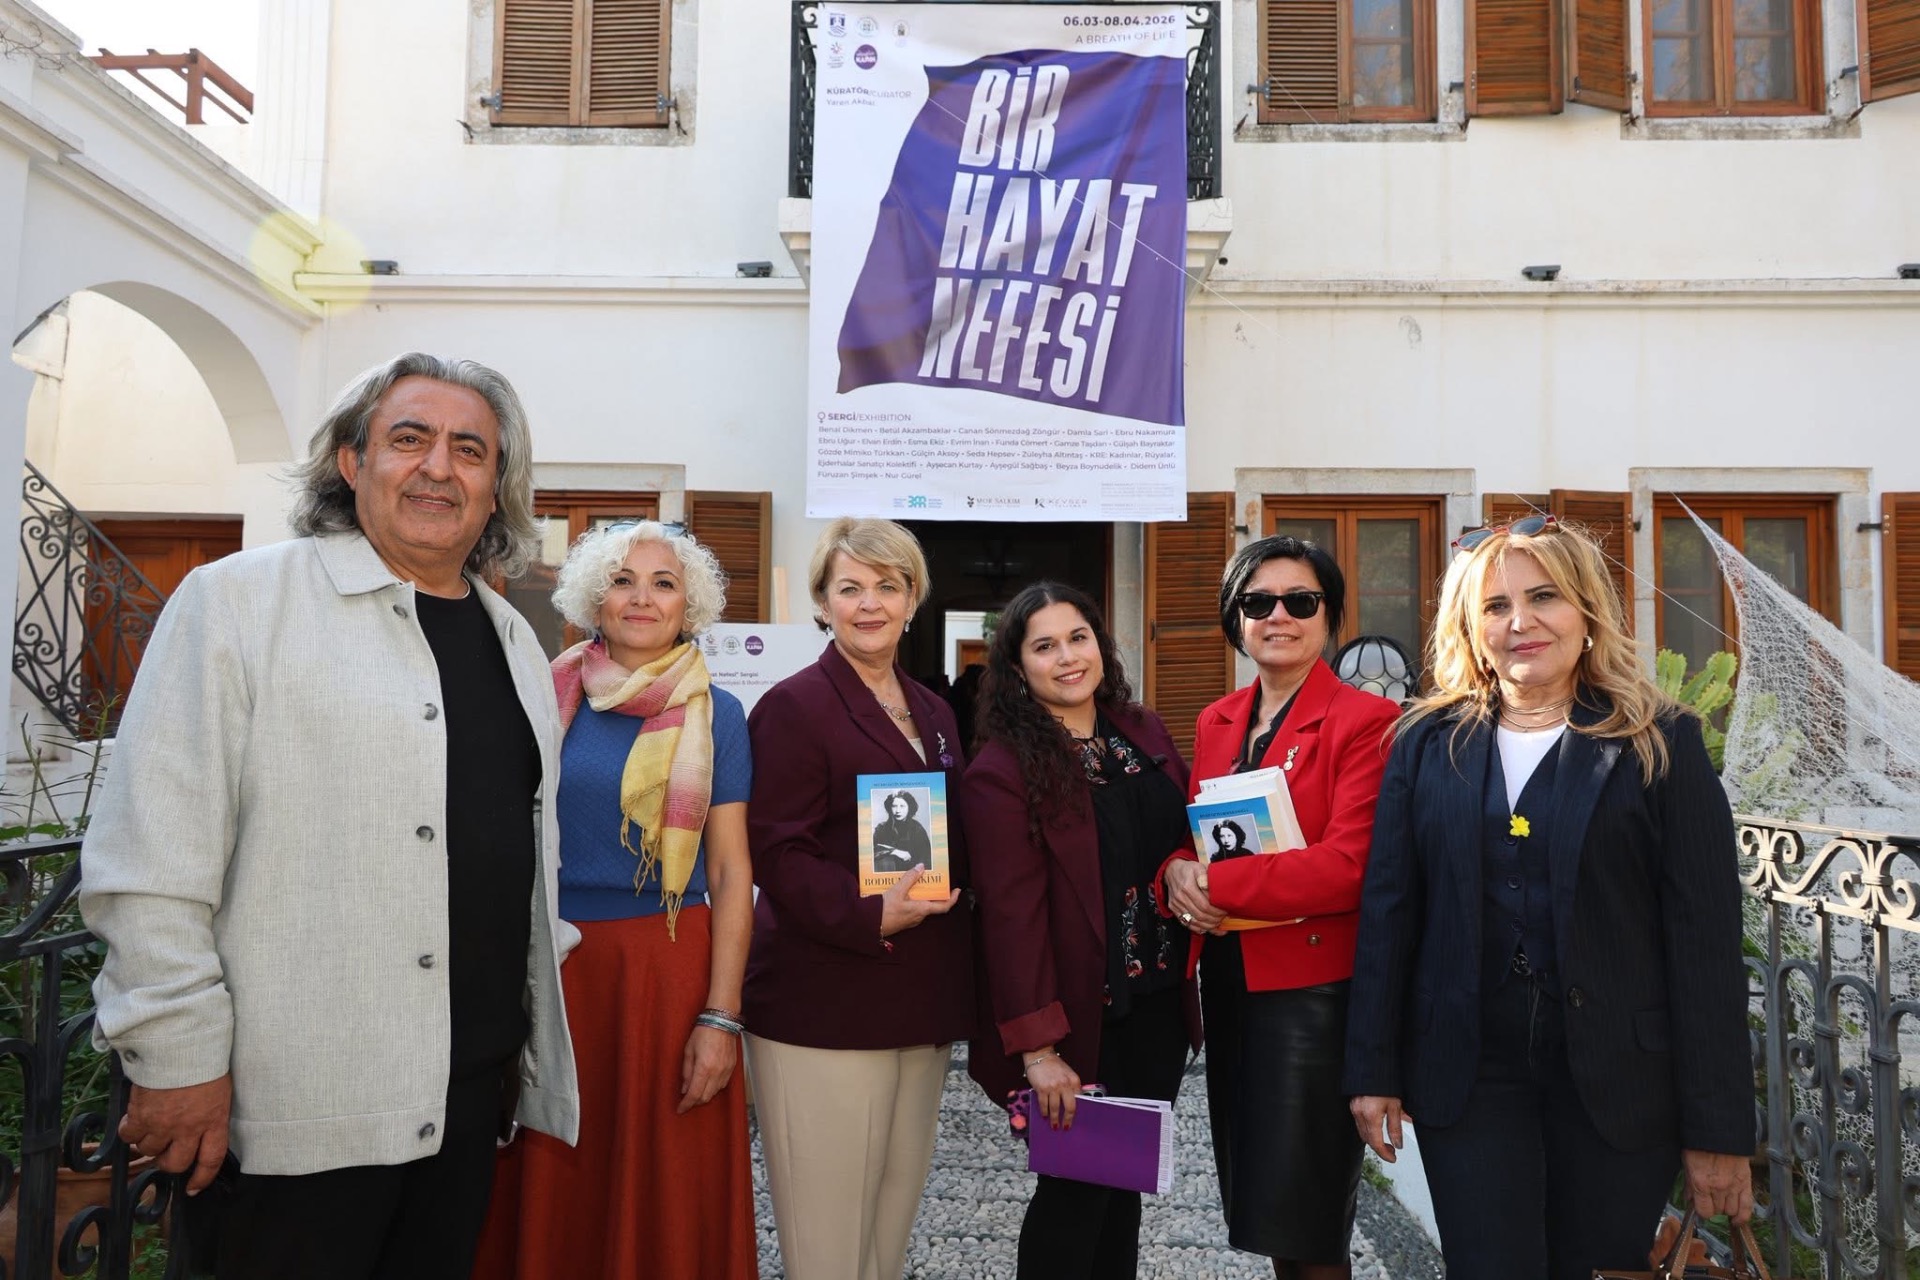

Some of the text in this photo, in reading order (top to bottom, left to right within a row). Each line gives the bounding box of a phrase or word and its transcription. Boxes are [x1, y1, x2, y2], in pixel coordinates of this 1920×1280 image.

[1063, 15, 1176, 26] 06.03-08.04.2026
[1075, 30, 1177, 44] A BREATH OF LIFE
[958, 64, 1070, 172] BİR
[938, 171, 1158, 288] HAYAT
[917, 276, 1121, 403] NEFESİ
[827, 411, 912, 421] SERGİ/EXHIBITION
[984, 427, 1031, 436] Sönmezdağ
[973, 438, 990, 446] İnan
[911, 449, 935, 457] Gülçin
[937, 450, 960, 458] Aksoy
[1022, 451, 1053, 459] Züleyha
[990, 462, 1020, 470] Ayşegül
[1021, 462, 1048, 470] Sağbaş
[1056, 463, 1078, 471] Beyza
[851, 471, 878, 479] Şimşek
[864, 877, 901, 886] BODRU
